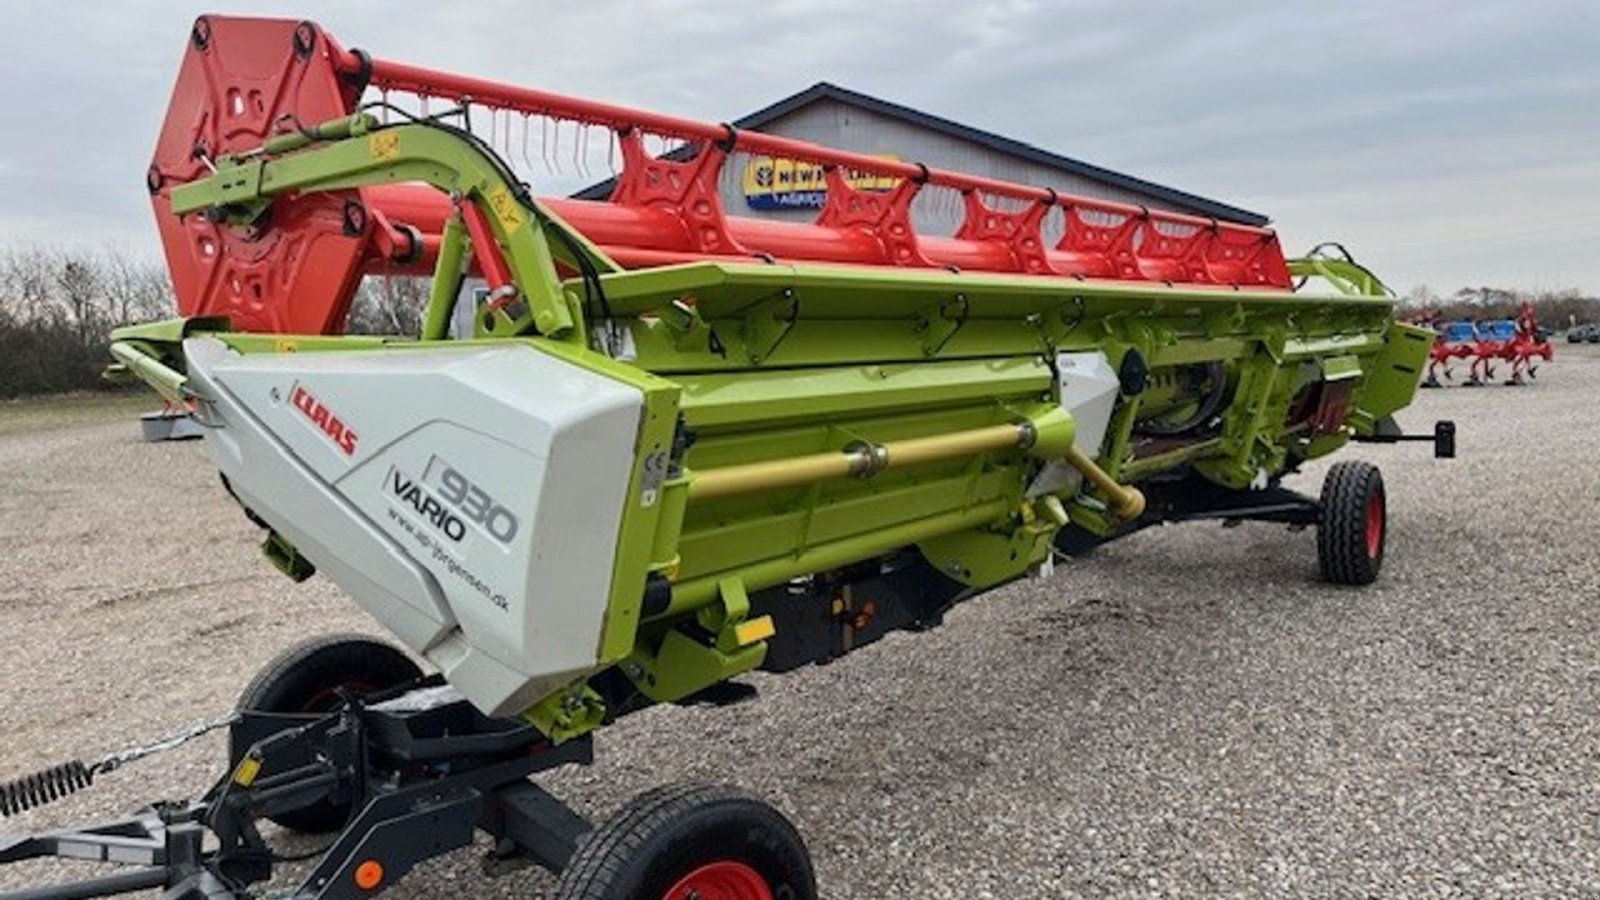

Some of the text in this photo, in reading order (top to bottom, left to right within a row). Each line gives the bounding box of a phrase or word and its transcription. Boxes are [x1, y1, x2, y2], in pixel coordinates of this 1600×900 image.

[292, 386, 359, 456] CLAAS
[392, 470, 466, 542] VARIO
[437, 467, 519, 544] 930
